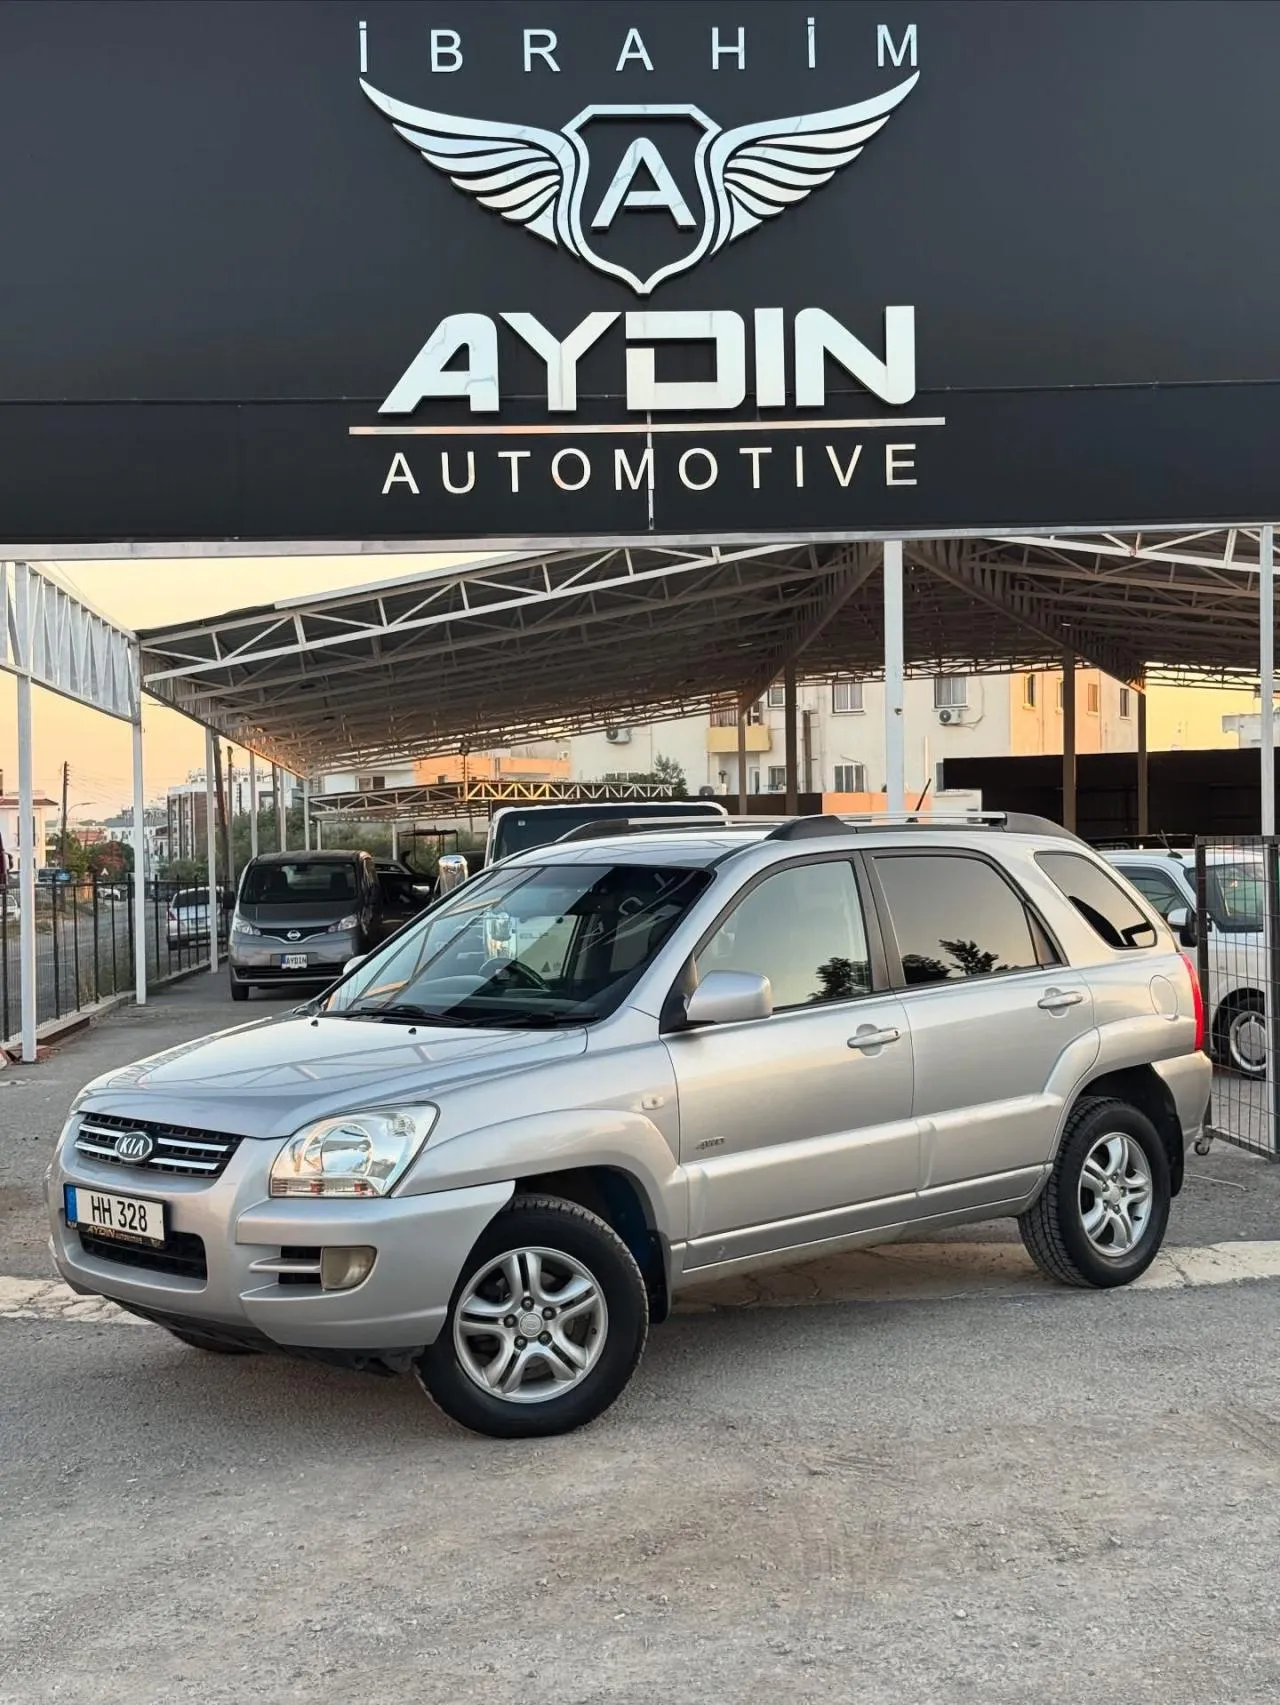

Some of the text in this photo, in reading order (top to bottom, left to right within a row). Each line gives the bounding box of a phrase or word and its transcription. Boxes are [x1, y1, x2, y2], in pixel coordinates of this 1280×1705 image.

[359, 17, 919, 72] İBRAHİM
[591, 137, 697, 230] A
[378, 305, 917, 414] AYDIN
[381, 443, 918, 495] AUTOMOTIVE
[119, 1137, 144, 1156] KIA
[91, 1195, 147, 1232] HH 328
